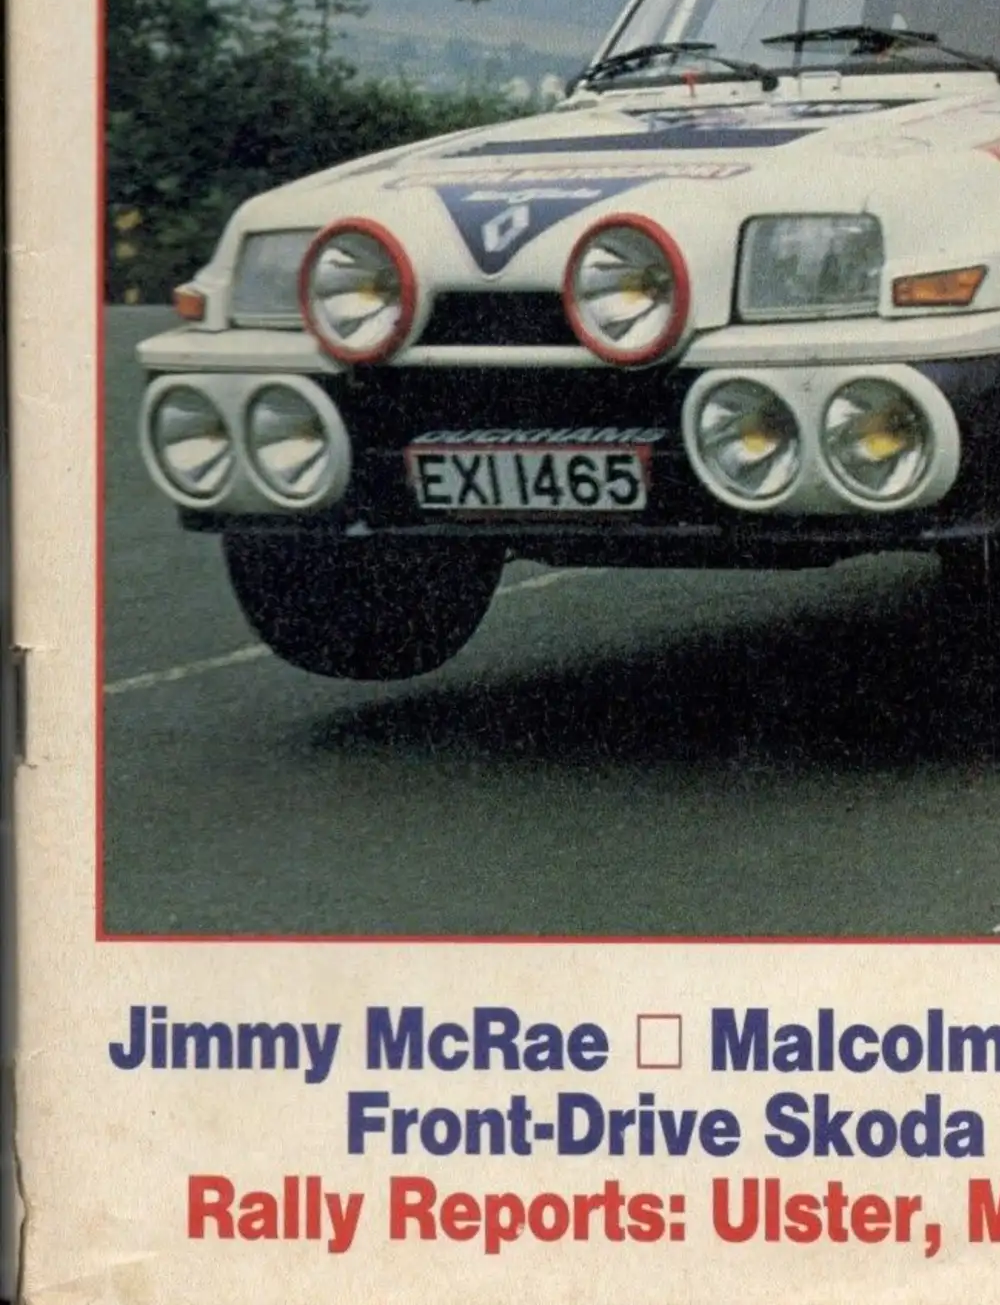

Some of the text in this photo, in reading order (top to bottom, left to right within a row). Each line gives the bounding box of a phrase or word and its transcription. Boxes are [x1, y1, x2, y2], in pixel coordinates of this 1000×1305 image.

[109, 1006, 609, 1084] Jimmy McRae
[348, 1092, 984, 1158] Front-Drive Skoda
[188, 1176, 363, 1253] Rally
[390, 1176, 686, 1254] Reports:
[713, 1178, 942, 1257] Ulster,
